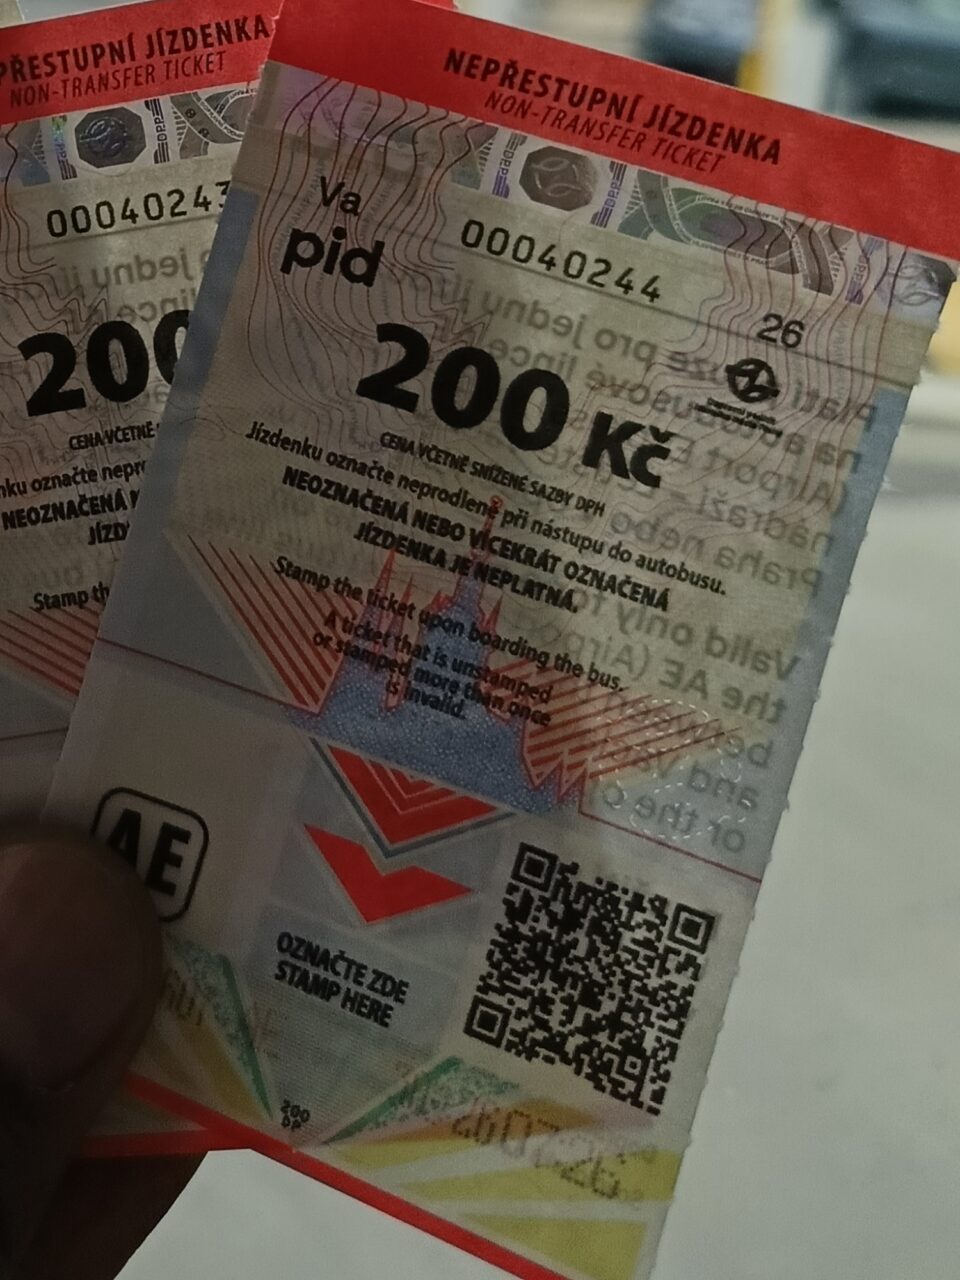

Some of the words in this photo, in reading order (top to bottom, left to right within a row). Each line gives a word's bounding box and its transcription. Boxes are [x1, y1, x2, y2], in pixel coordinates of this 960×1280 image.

[145, 14, 271, 60] JÍZDENKA
[9, 64, 156, 108] NON-TRANSFER
[163, 50, 227, 78] TICKET
[443, 47, 644, 125] NEPŘESTUPNÍ
[645, 103, 784, 166] JÍZDENKA
[484, 90, 647, 153] NON-TRANSFER
[652, 138, 726, 174] TICKET
[319, 175, 362, 217] Va
[280, 226, 387, 289] pid
[461, 219, 661, 304] 00040244
[756, 312, 805, 349] 26
[69, 430, 106, 451] CENA
[106, 420, 155, 446] VČETNĚ
[355, 322, 569, 452] 200
[581, 410, 677, 489] Kč
[1, 487, 128, 531] NEOZNAČENÁ
[31, 464, 98, 494] označte
[245, 421, 324, 462] Jízdenku
[326, 450, 394, 485] označte
[397, 473, 500, 517] neprodleně
[500, 507, 530, 530] při
[530, 517, 605, 555] nástupu
[607, 541, 633, 564] do
[635, 550, 727, 596] autobusu.
[380, 431, 415, 457] CENA
[418, 442, 470, 472] VČETNĚ
[469, 461, 529, 493] SNÍŽENÉ
[530, 481, 574, 507] SAZBY
[575, 494, 606, 517] DPH
[282, 466, 409, 525] NEOZNAČENÁ
[413, 509, 465, 542] NEBO
[469, 528, 562, 574] VÍCEKRÁT
[563, 560, 670, 612] OZNAČENÁ
[354, 521, 446, 570] JÍZDENKA
[448, 556, 470, 577] JE
[473, 558, 578, 614] NEPLATNÁ.
[33, 585, 90, 612] Stamp
[276, 555, 330, 593] Stamp
[333, 574, 363, 601] the
[365, 587, 416, 621] ticket
[419, 610, 465, 642] upon
[467, 622, 551, 668] boarding
[554, 652, 584, 678] the
[587, 662, 625, 693] bus.
[312, 631, 334, 650] or
[335, 639, 412, 679] stamped
[414, 666, 461, 695] more
[507, 699, 552, 727] once
[324, 609, 338, 631] A
[341, 615, 392, 647] ticket
[394, 631, 431, 662] that
[433, 647, 448, 669] is
[451, 659, 554, 705] unstamped
[406, 684, 467, 719] invalid.
[107, 807, 192, 898] AE
[273, 960, 341, 1003] STAMP
[340, 990, 395, 1029] HERE
[275, 932, 369, 989] OZNAČTE
[367, 969, 410, 1006] ZDE
